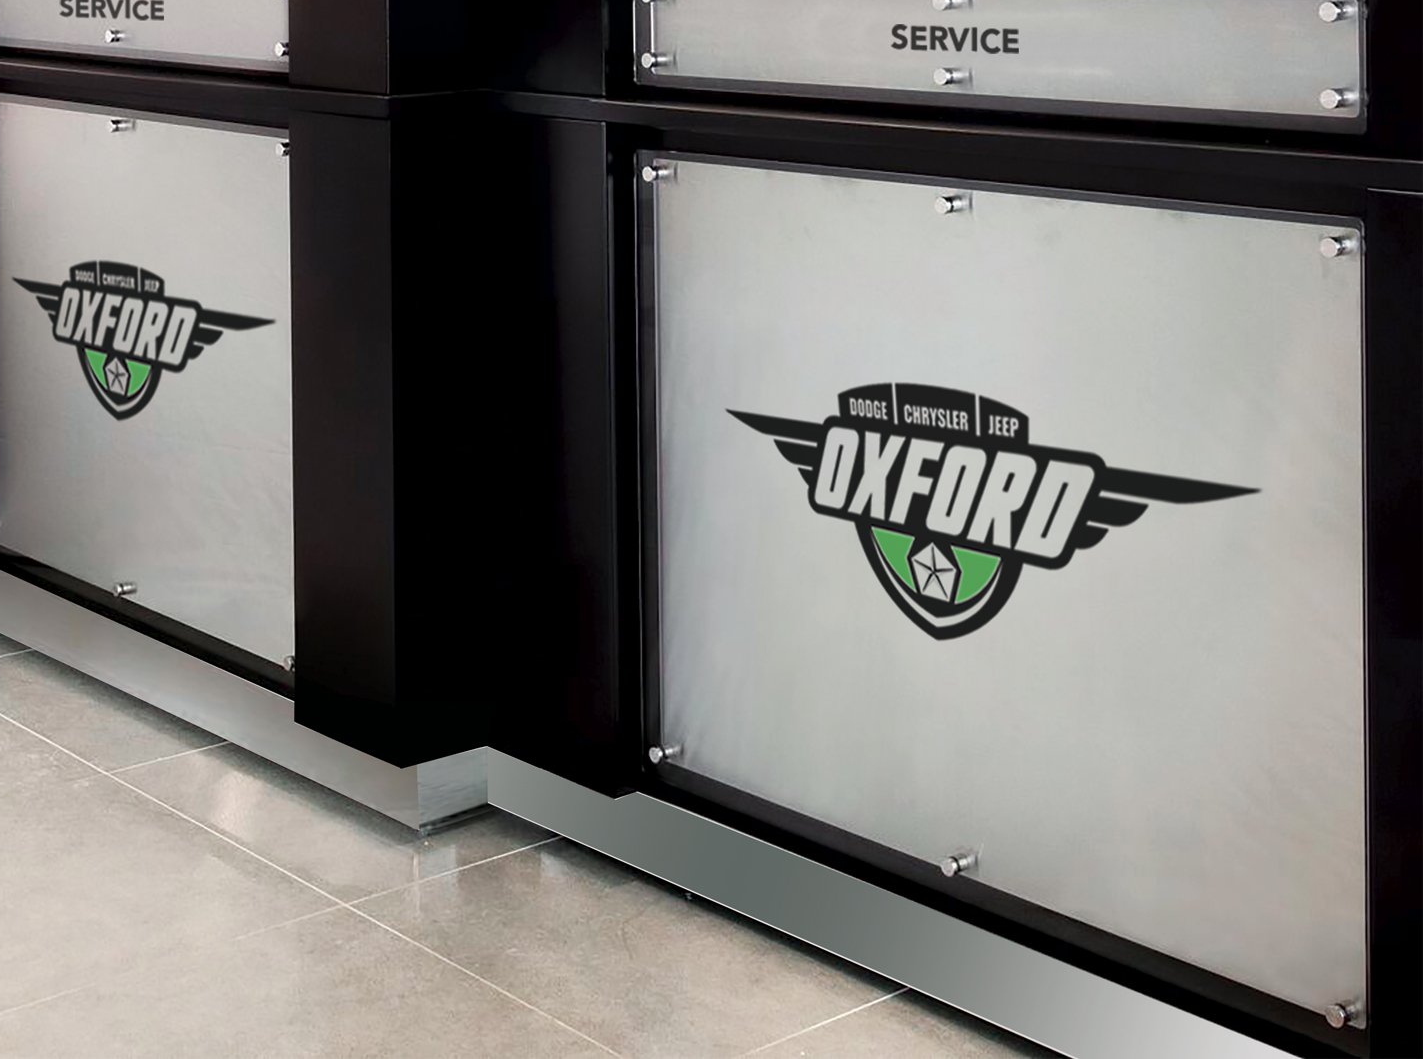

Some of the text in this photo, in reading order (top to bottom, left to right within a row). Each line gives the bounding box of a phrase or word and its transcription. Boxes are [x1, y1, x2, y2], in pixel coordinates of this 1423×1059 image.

[890, 23, 1020, 55] SERVICE
[75, 270, 160, 292] DODGE CHRYSLER JEEP
[54, 286, 198, 367] OXFORD
[849, 397, 1020, 437] DODGE CHRYSLER JEEP
[814, 426, 1096, 559] OXFORD
